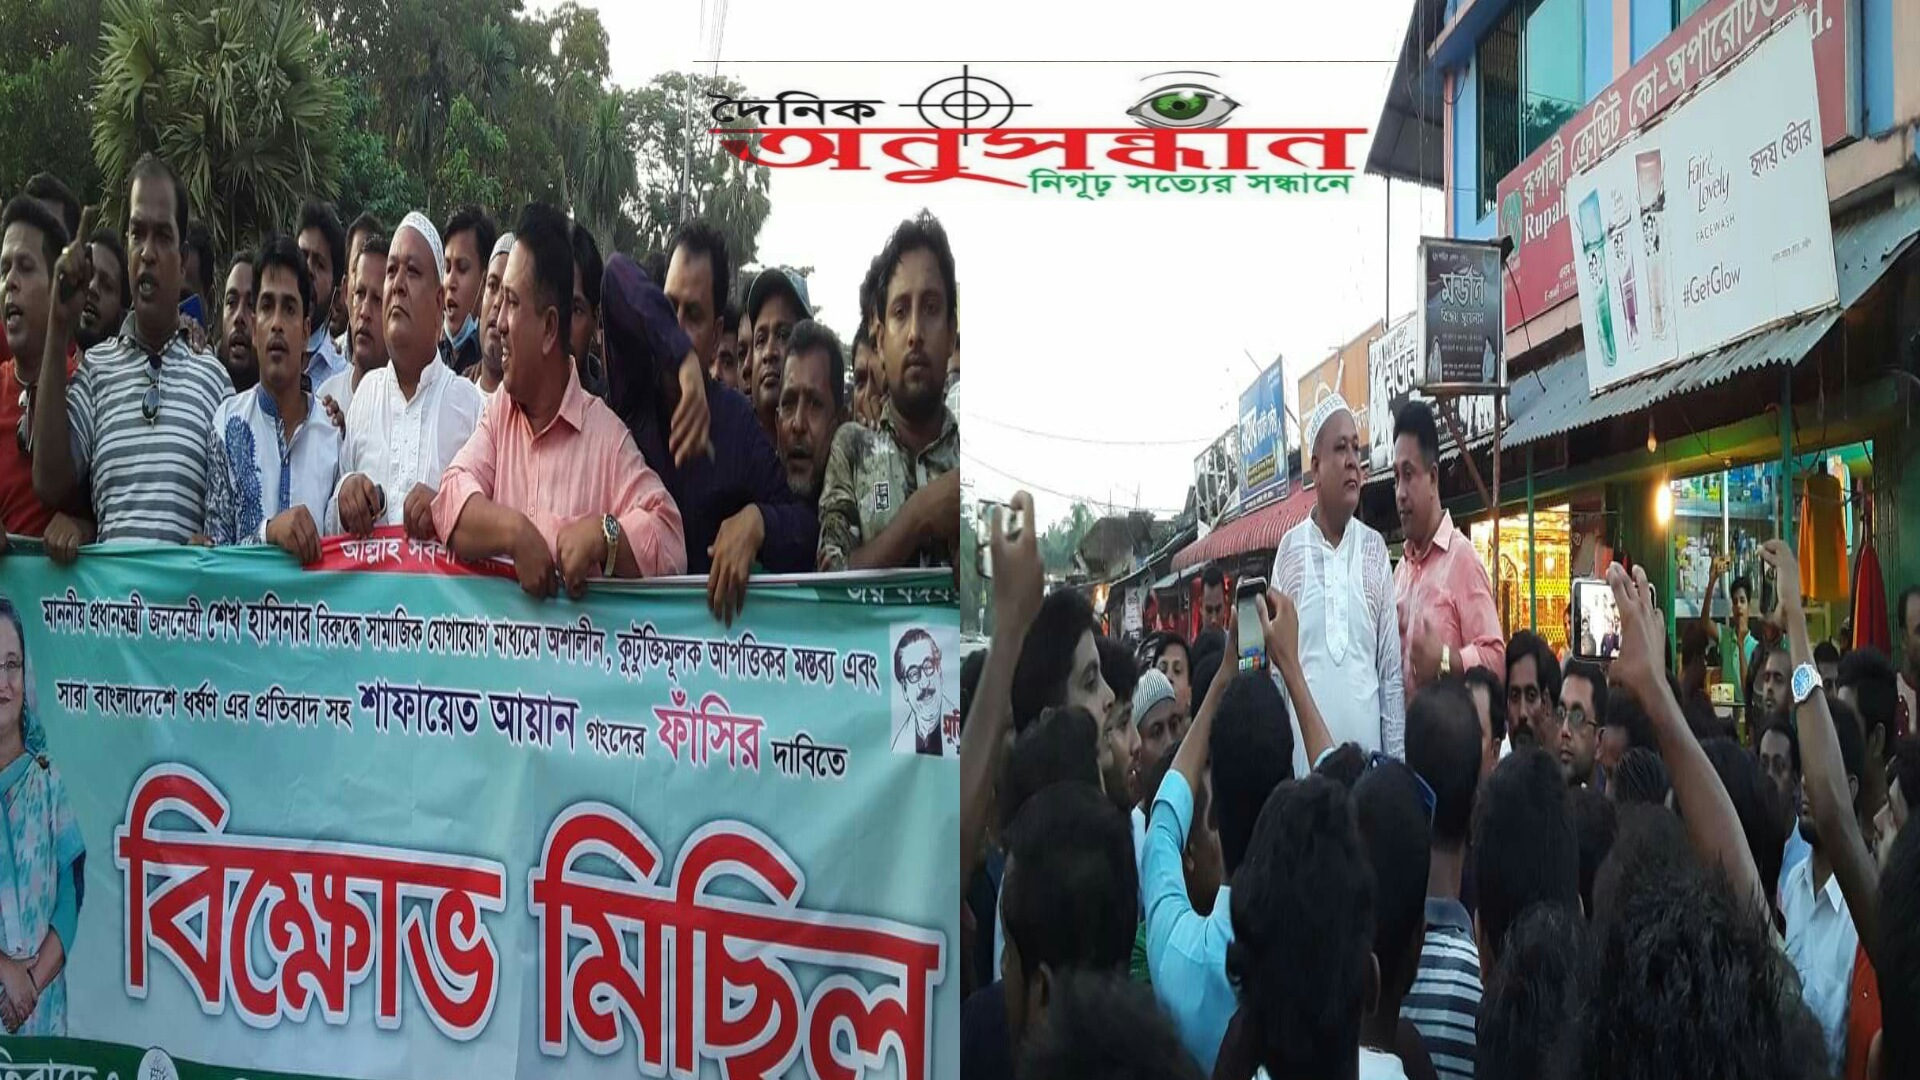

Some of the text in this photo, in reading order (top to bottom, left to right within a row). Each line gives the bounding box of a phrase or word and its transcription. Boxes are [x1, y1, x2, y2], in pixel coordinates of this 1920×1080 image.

[1523, 135, 1565, 207] রূপালী
[1698, 166, 1730, 213] Lovely
[1695, 212, 1736, 244] FACEWASH
[1683, 260, 1741, 308] #GetGlow
[42, 589, 86, 632] মাননীয়
[89, 590, 143, 636] প্রধানমন্ত্রী
[148, 597, 203, 639] জননেত্রী
[207, 599, 243, 639] শেখ
[247, 593, 313, 646] হাসিনার
[315, 605, 362, 648] বিরুদ্ধে
[365, 608, 424, 648] সামাজিক
[427, 617, 489, 653] যোগাযোগ
[493, 621, 541, 658] মাধ্যমে
[707, 633, 788, 679] আপত্তিকর
[792, 647, 836, 684] মন্তব্য
[842, 651, 880, 691] এবং
[57, 680, 848, 777] সারা বাংলাদেশে ধর্ষণ এর প্রতিবাদ সহ শাফায়েত আয়ান গংদের ফাঁসির দাবিতে
[118, 770, 942, 1080] বিক্ষোভ মিছিল
